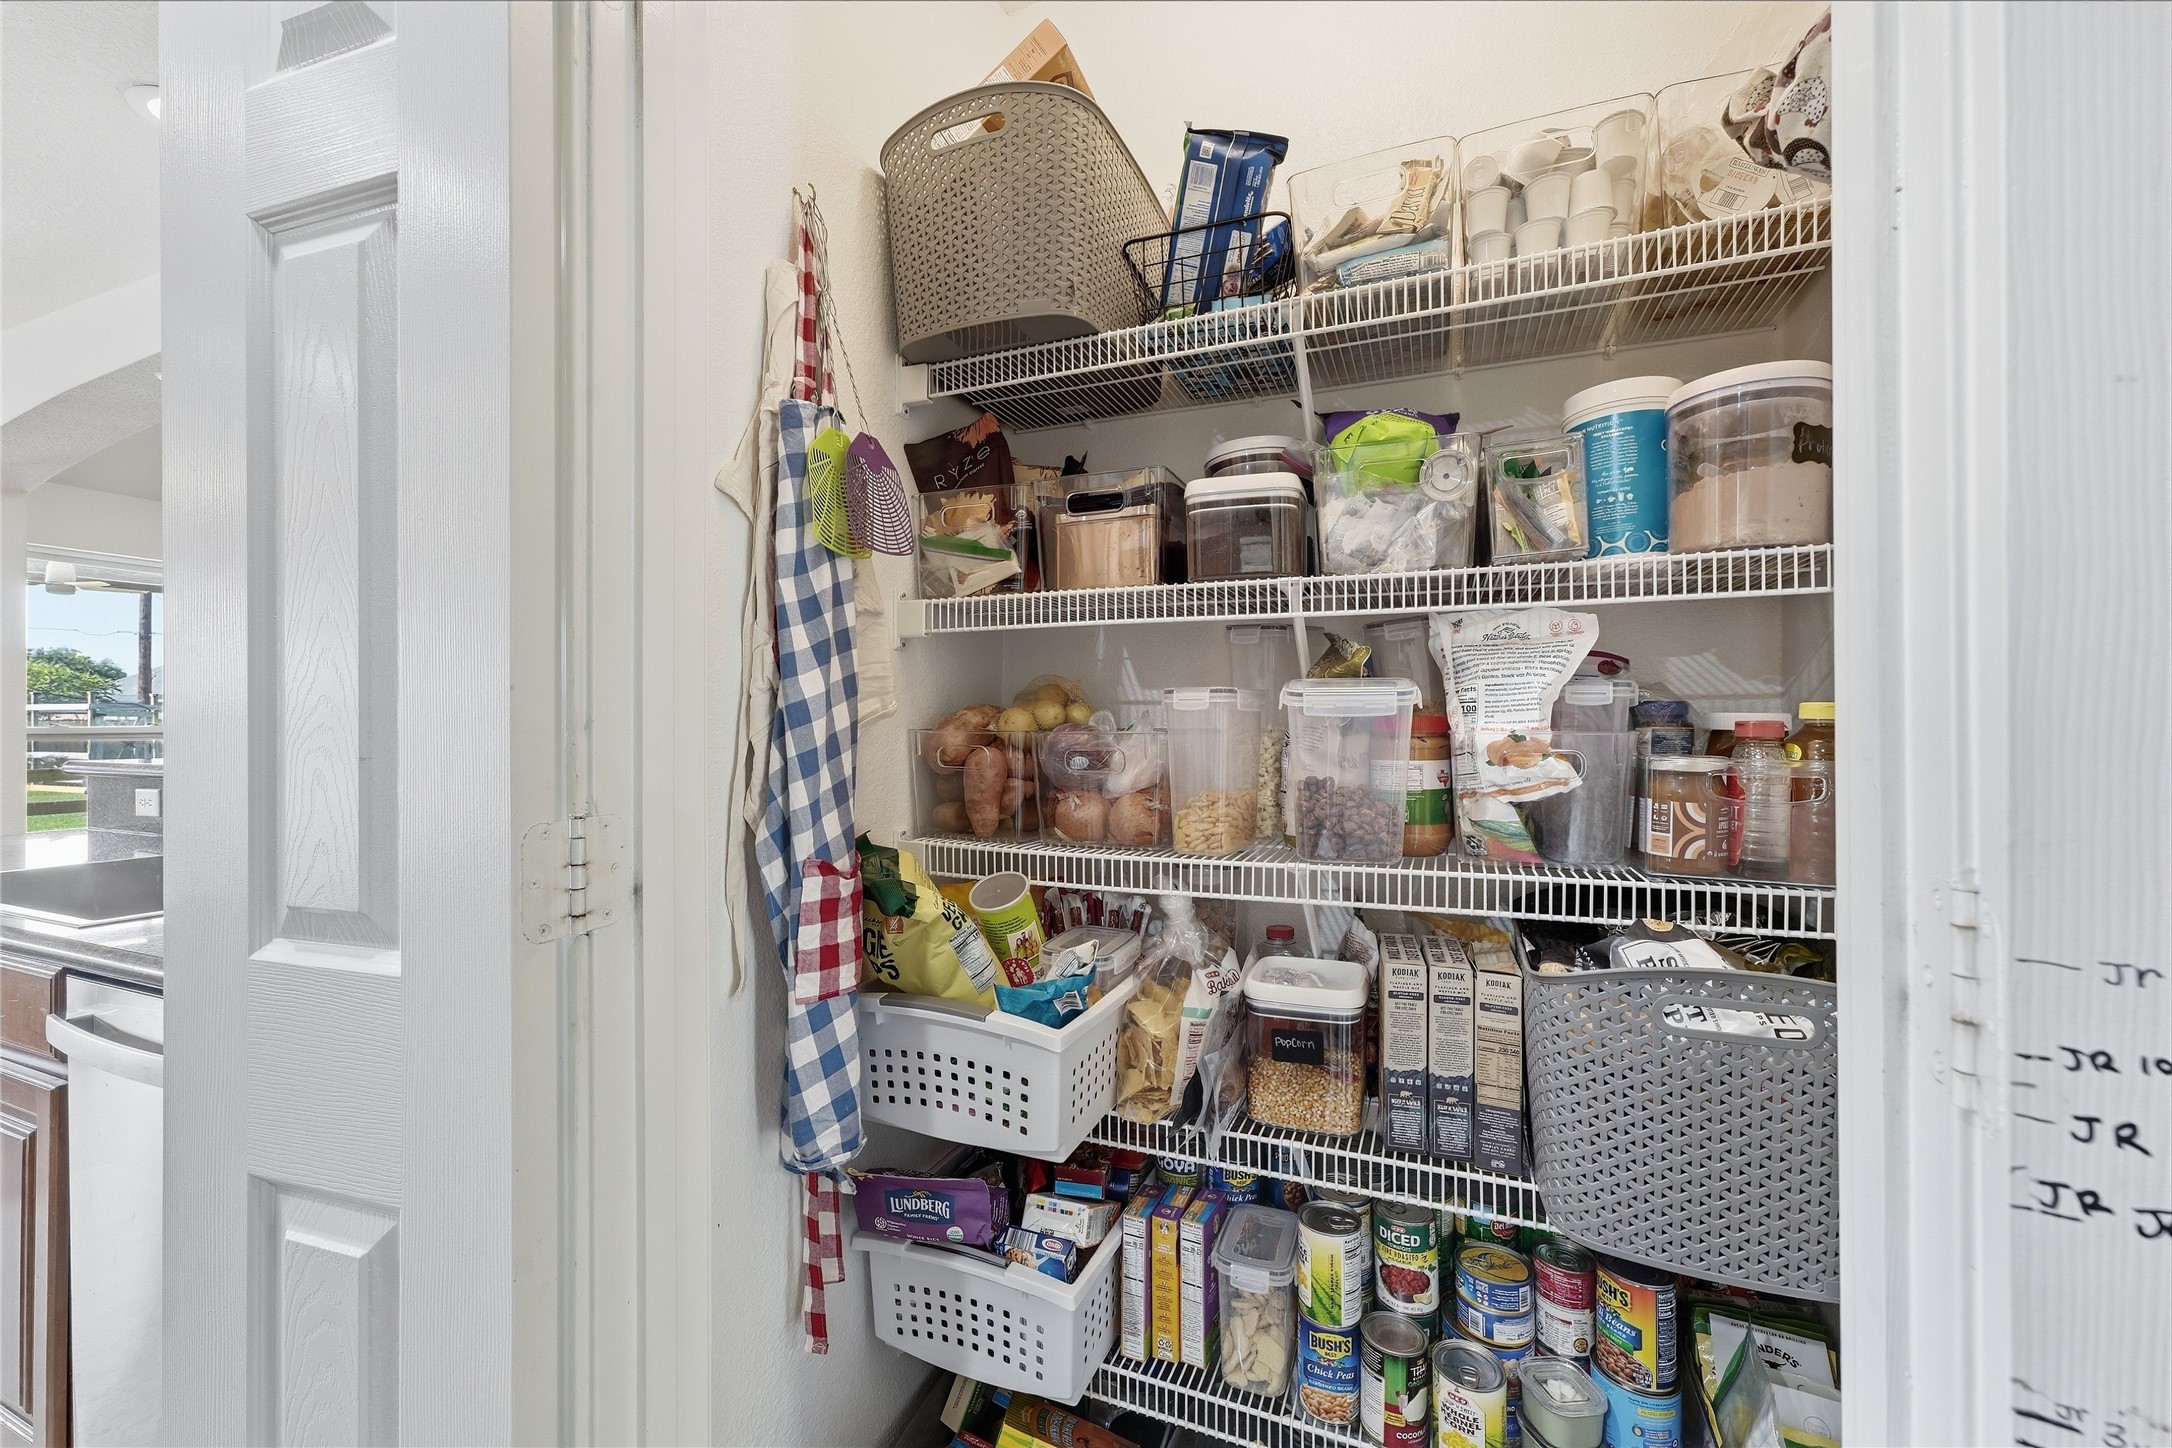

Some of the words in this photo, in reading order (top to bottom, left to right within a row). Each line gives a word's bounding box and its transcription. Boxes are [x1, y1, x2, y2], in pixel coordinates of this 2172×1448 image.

[1461, 704, 1477, 713] 100
[1392, 968, 1420, 978] KODIAK
[1437, 972, 1466, 982] KODIAK
[1486, 980, 1512, 990] KODIAK
[1477, 1026, 1503, 1034] Nutrition
[2057, 1045, 2121, 1073] JR
[2069, 1115, 2154, 1157] JR
[1163, 1173, 1198, 1186] GANICS
[890, 1196, 950, 1219] LUNDBERG
[1226, 1193, 1243, 1202] hick
[2033, 1178, 2115, 1217] JR
[1379, 1225, 1421, 1248] DICED
[1394, 1252, 1419, 1261] ROASTED
[1598, 1275, 1629, 1308] USH'S
[1605, 1313, 1637, 1337] Beans
[1310, 1333, 1351, 1354] BUSH'S
[1757, 1344, 1800, 1369] NDER'S
[1307, 1363, 1334, 1379] Chick
[1336, 1370, 1355, 1380] Peas
[1441, 1400, 1480, 1424] WHOLE
[1441, 1406, 1482, 1431] KERNEL
[1444, 1416, 1475, 1436] CORN
